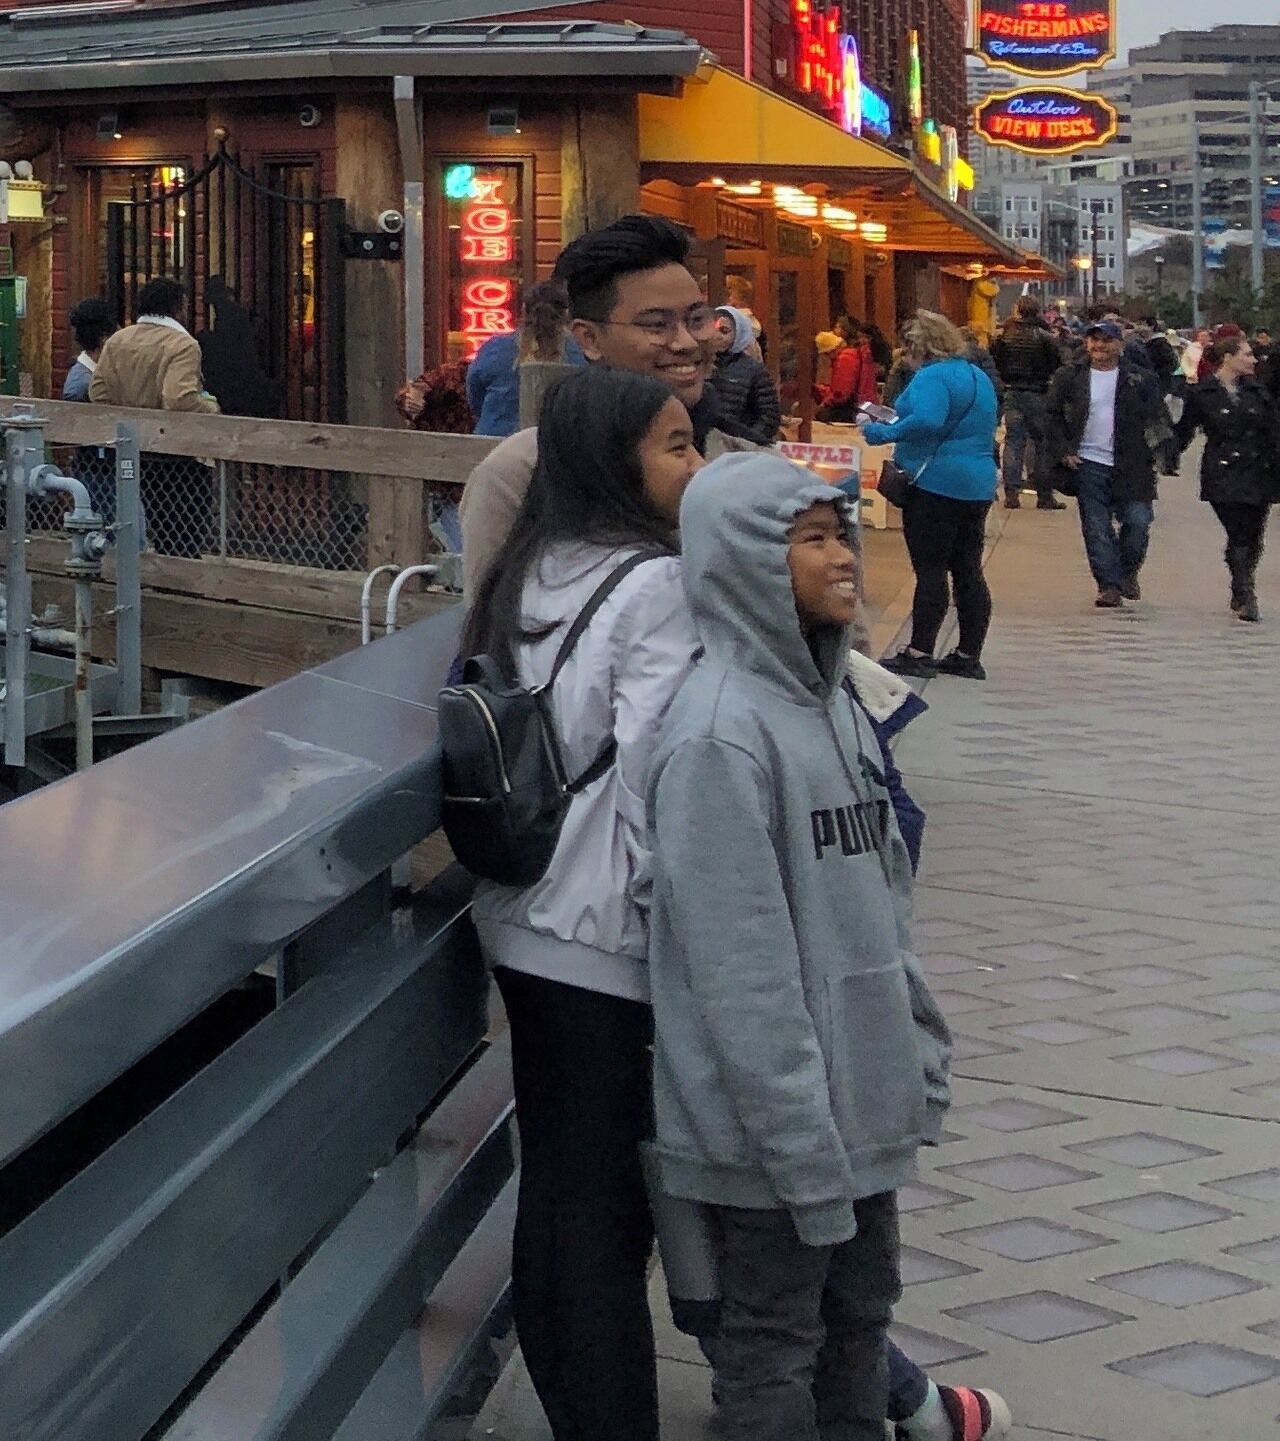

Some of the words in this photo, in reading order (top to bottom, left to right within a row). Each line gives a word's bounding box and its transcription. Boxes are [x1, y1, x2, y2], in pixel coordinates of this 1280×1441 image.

[1021, 3, 1068, 17] THE
[981, 12, 1109, 37] FISHERMANS
[1007, 98, 1081, 114] Outdoor
[991, 116, 1041, 138] VIEW
[1047, 116, 1096, 138] DECK
[463, 179, 512, 260] ICE
